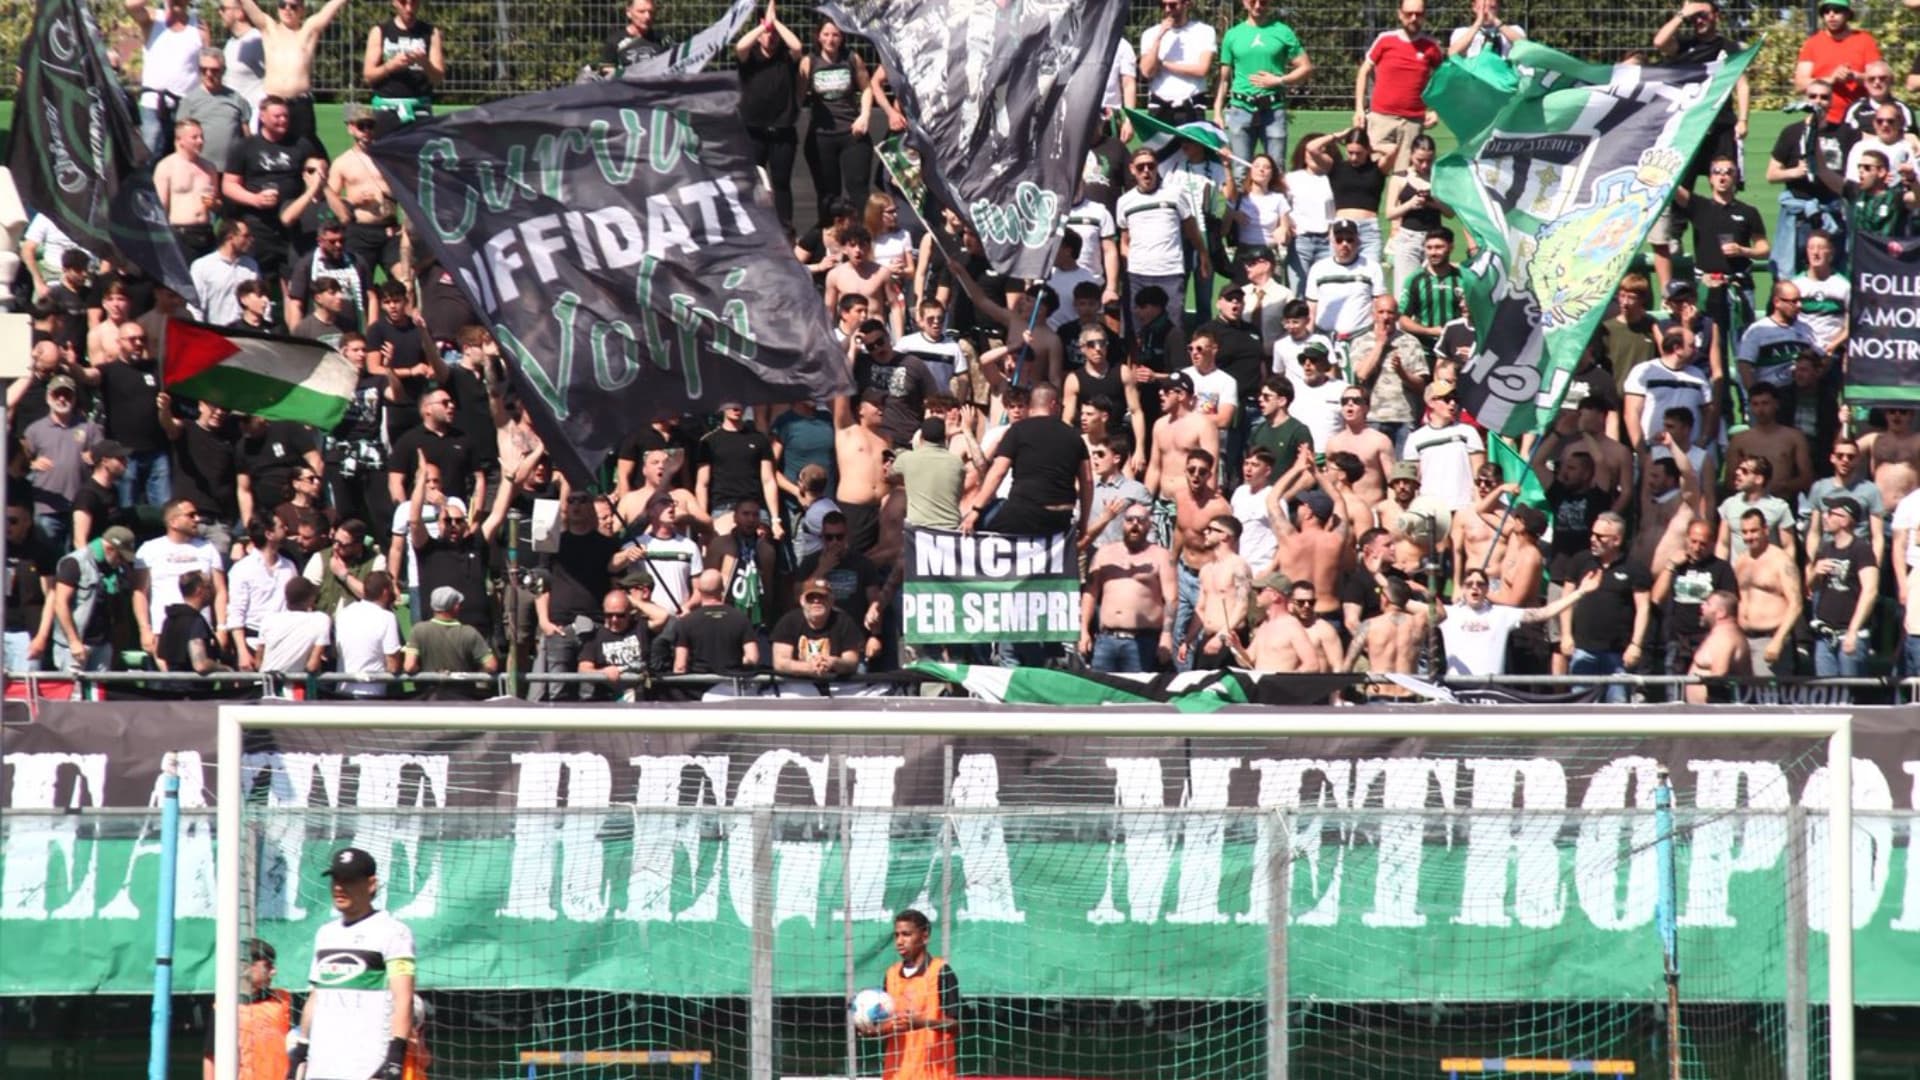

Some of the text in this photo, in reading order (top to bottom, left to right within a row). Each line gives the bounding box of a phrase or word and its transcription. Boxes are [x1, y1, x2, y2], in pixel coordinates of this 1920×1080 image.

[496, 254, 758, 420] Volpi
[1848, 336, 1920, 361] NOSTR
[914, 530, 1066, 578] MICHI
[903, 590, 1081, 635] PER SEMPRE
[494, 748, 1026, 930] REGIA
